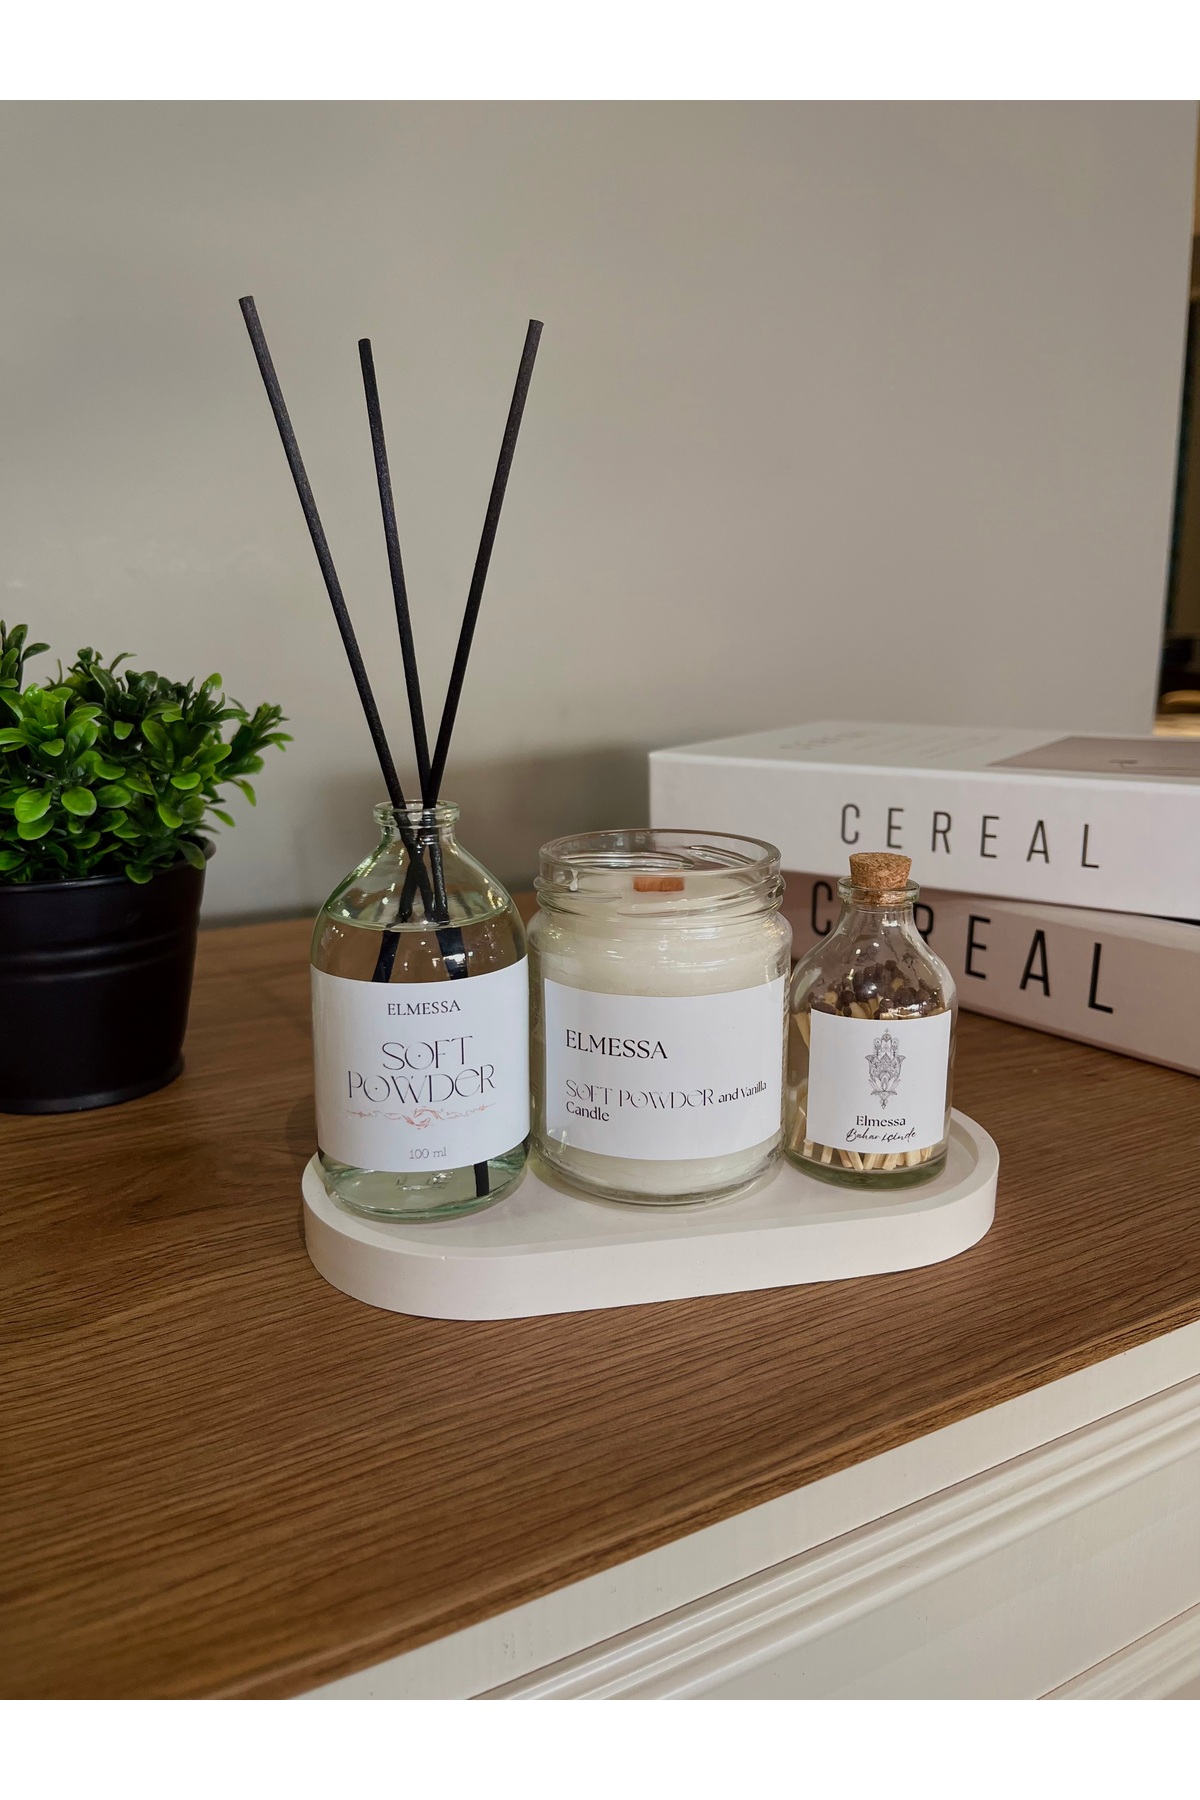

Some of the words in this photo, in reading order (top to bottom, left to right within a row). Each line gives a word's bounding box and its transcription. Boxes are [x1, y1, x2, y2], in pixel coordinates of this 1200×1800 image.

[840, 803, 1101, 869] CEREAL
[810, 880, 1114, 1014] CREAL
[387, 1000, 461, 1016] ELMESSA
[381, 1035, 473, 1070] SOFT
[565, 1029, 668, 1059] ELMESSA
[565, 1079, 613, 1105] SOFT
[718, 1088, 739, 1103] and
[740, 1080, 767, 1098] Vanilla
[566, 1101, 610, 1122] Candle
[856, 1115, 906, 1127] Elmessa
[409, 1148, 430, 1160] 100
[433, 1147, 447, 1158] ml
